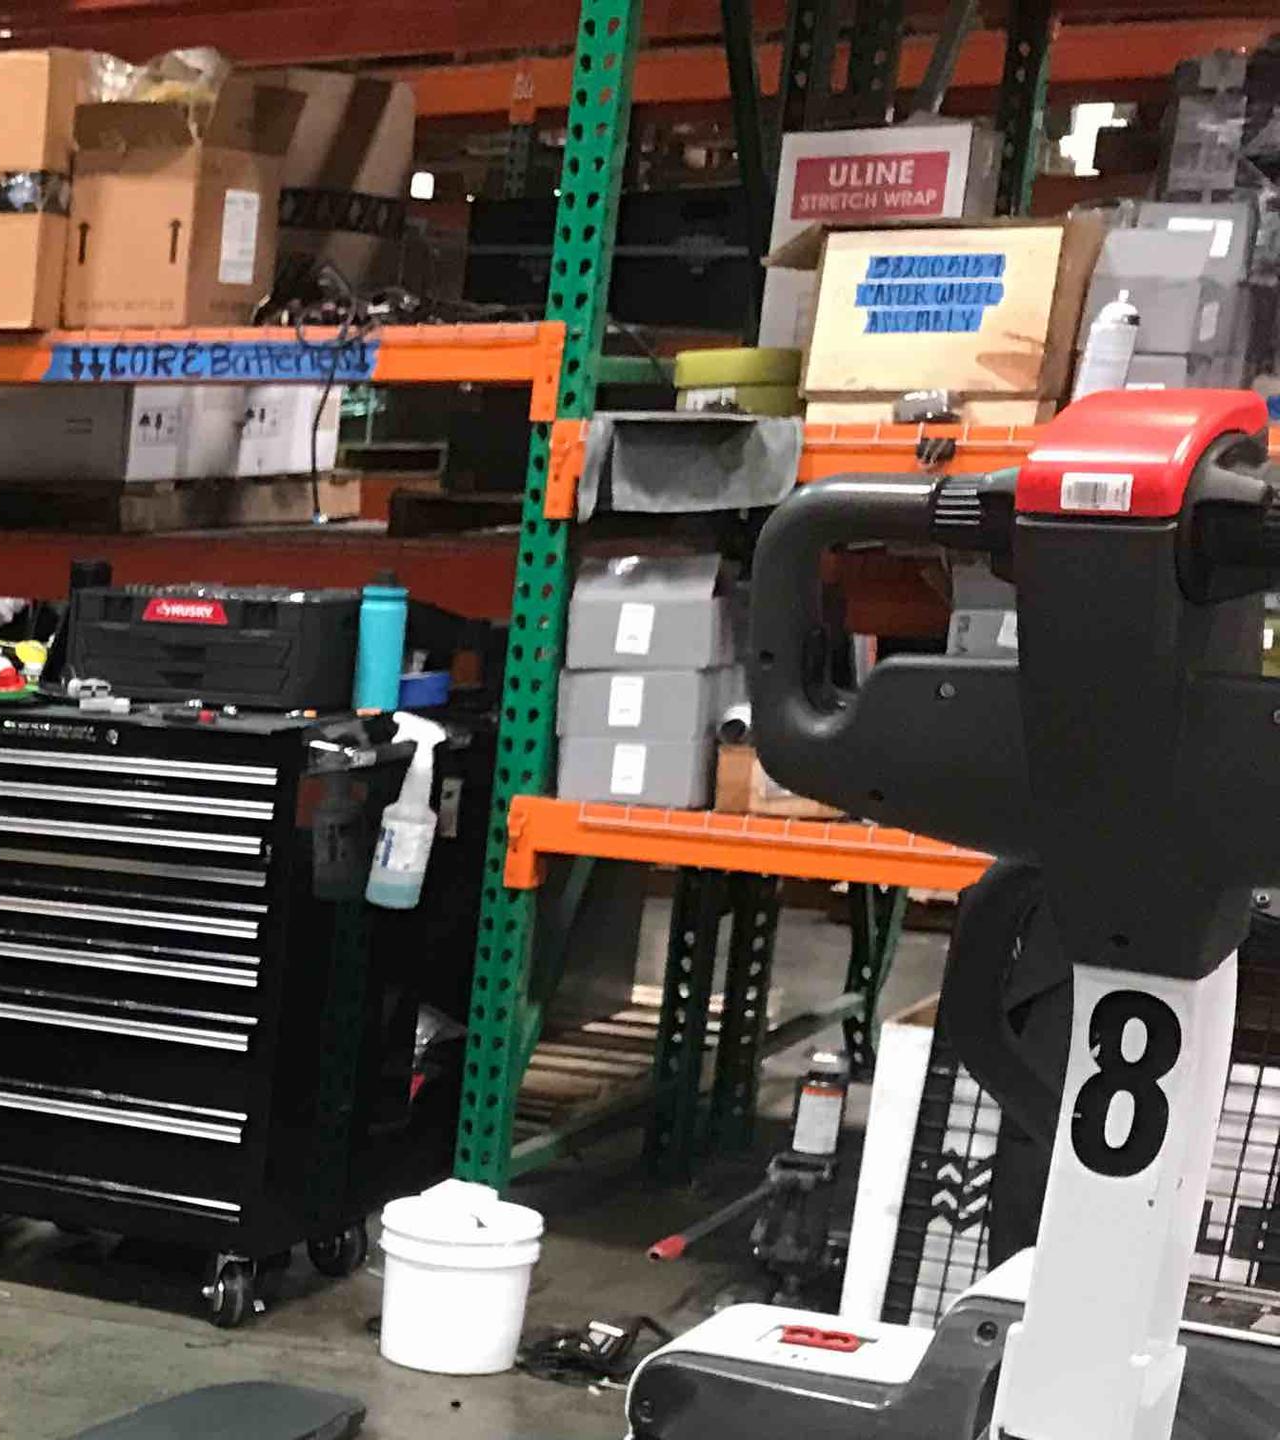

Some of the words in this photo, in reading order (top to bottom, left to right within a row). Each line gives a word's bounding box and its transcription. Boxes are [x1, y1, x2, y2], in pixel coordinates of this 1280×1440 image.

[829, 160, 915, 187] ULINE
[799, 191, 877, 211] STRETCH
[884, 188, 937, 207] WRAP
[171, 603, 214, 618] HUSKY
[1071, 989, 1182, 1178] 8
